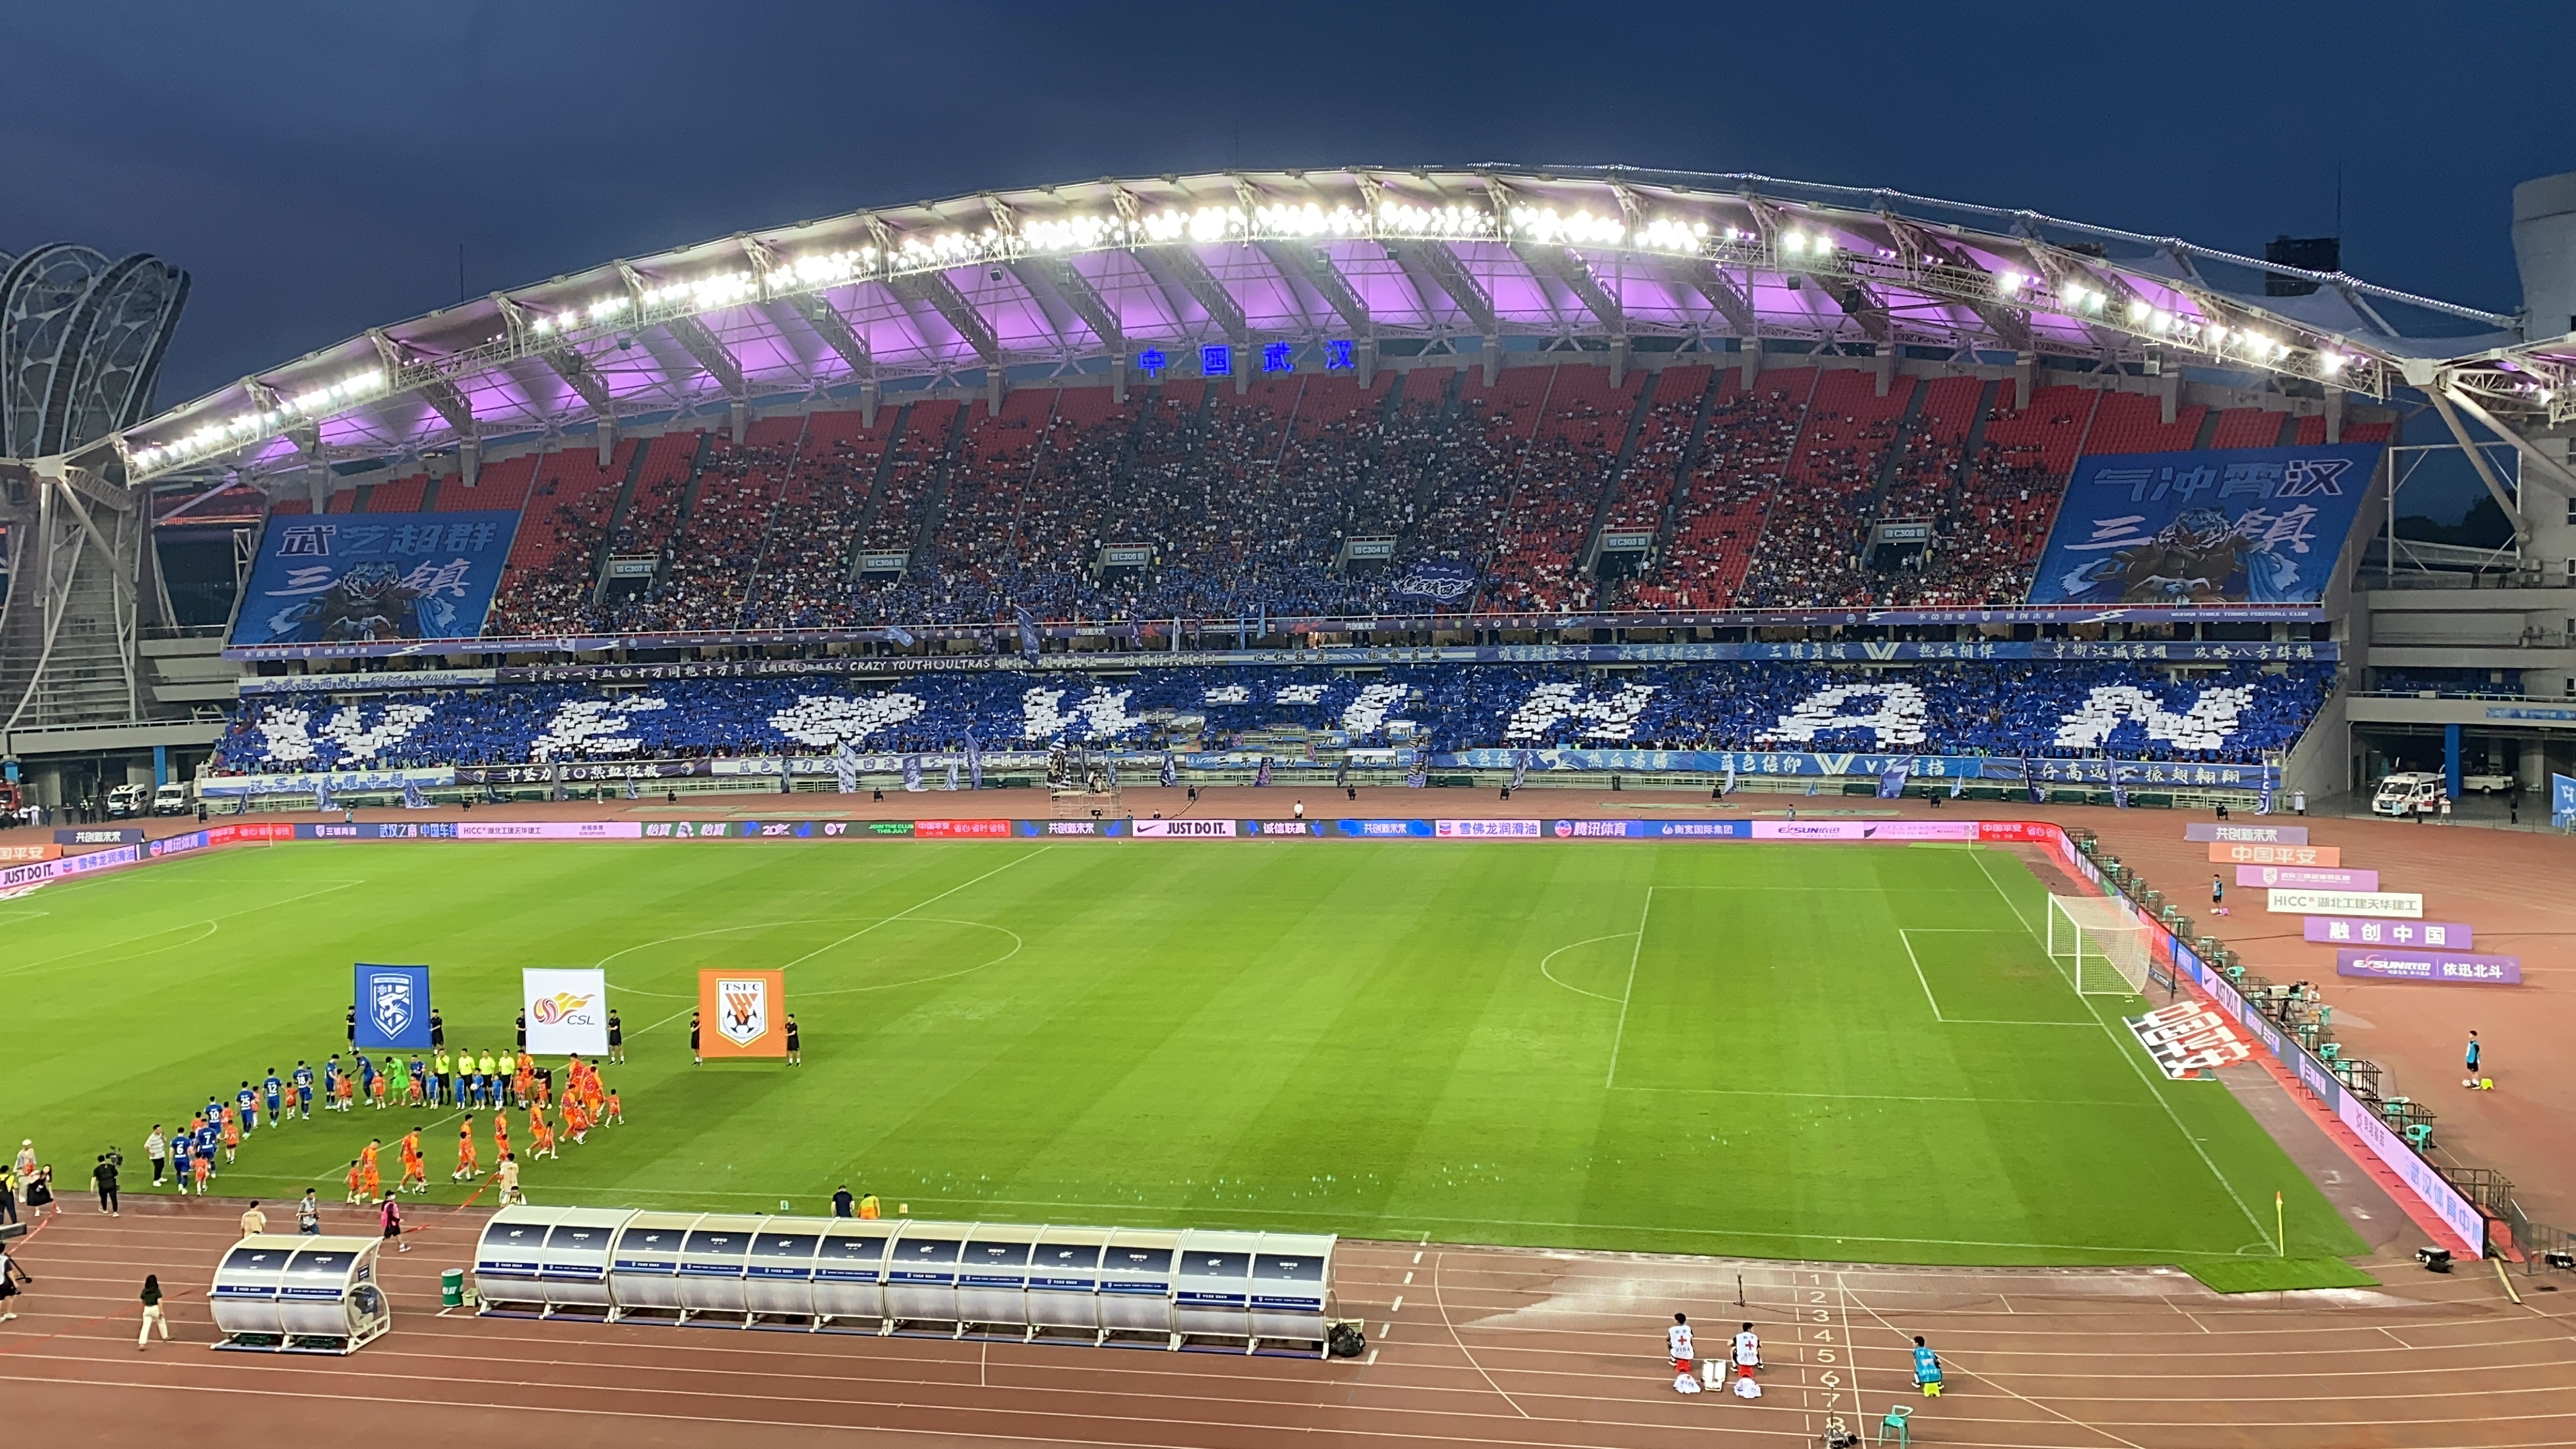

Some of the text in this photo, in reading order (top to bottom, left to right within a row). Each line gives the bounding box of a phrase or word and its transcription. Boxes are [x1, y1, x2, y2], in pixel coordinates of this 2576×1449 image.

[1138, 339, 1354, 378] 中国武汉
[2094, 459, 2353, 502] 气冲霄汉
[1894, 529, 1916, 537] C302
[2063, 504, 2318, 553] 三镇
[276, 522, 498, 557] 武艺超群
[265, 557, 471, 598] 三镇
[1254, 650, 1328, 664] 心怀猛虎
[1919, 643, 1995, 659] 热血相伴
[2195, 644, 2314, 661] 攻略八方群雄
[850, 661, 887, 671] CRAZY
[892, 659, 932, 670] YOUTH
[945, 659, 990, 669] ULTRAS
[1110, 653, 1215, 667] 一路同行共战斗!
[510, 667, 614, 682] 一寸丹心一寸血
[636, 663, 745, 678] 十万同袍十万军
[262, 673, 458, 692] 为武汉而战! FORZA WUHAN
[1721, 753, 1802, 774] 蓝色信仰
[506, 763, 663, 783] 中坚力量 热血狂放
[2145, 765, 2239, 785] 振翅翱翔
[248, 772, 406, 794] 汉军威武耀中超
[379, 822, 459, 838] 武汉之南 中国车谷
[1048, 822, 1095, 834] 共创新未来
[1167, 822, 1226, 834] JUST DO IT.
[1263, 822, 1306, 834] 诚信联赛
[1364, 823, 1407, 834] 共创新未来
[1459, 822, 1538, 835] 雪佛龙润滑油
[1573, 822, 1627, 836] 腾讯体育
[1982, 824, 2023, 833] 中国平安
[2216, 826, 2278, 843] 共创新未来
[76, 831, 121, 843] 共创新未来
[78, 850, 136, 870] 雪佛龙润滑油
[2231, 845, 2316, 865] 中国平安
[3, 864, 54, 884] JUST DO IT.
[2273, 896, 2418, 911] HICC 湖北工建天华建工
[2329, 921, 2446, 945] 融创中国
[2443, 963, 2504, 978] 依迅北斗
[722, 983, 759, 991] TSFC
[2215, 978, 2226, 1006] JUST
[567, 1014, 595, 1025] CSL
[268, 1084, 277, 1093] 12
[297, 1077, 306, 1085] 18
[241, 1097, 250, 1107] 25
[209, 1111, 219, 1120] 10
[205, 1136, 211, 1144] 7
[176, 1144, 183, 1154] 6
[2410, 1161, 2483, 1248] 武汉体育中心
[1811, 1275, 1820, 1285] 1
[1811, 1292, 1827, 1303] 2
[1813, 1309, 1829, 1322] 3
[1814, 1330, 1833, 1342] 4
[1817, 1350, 1835, 1363] 5
[1820, 1370, 1840, 1385] 6
[1821, 1392, 1840, 1407] 7
[1825, 1417, 1846, 1432] 8
